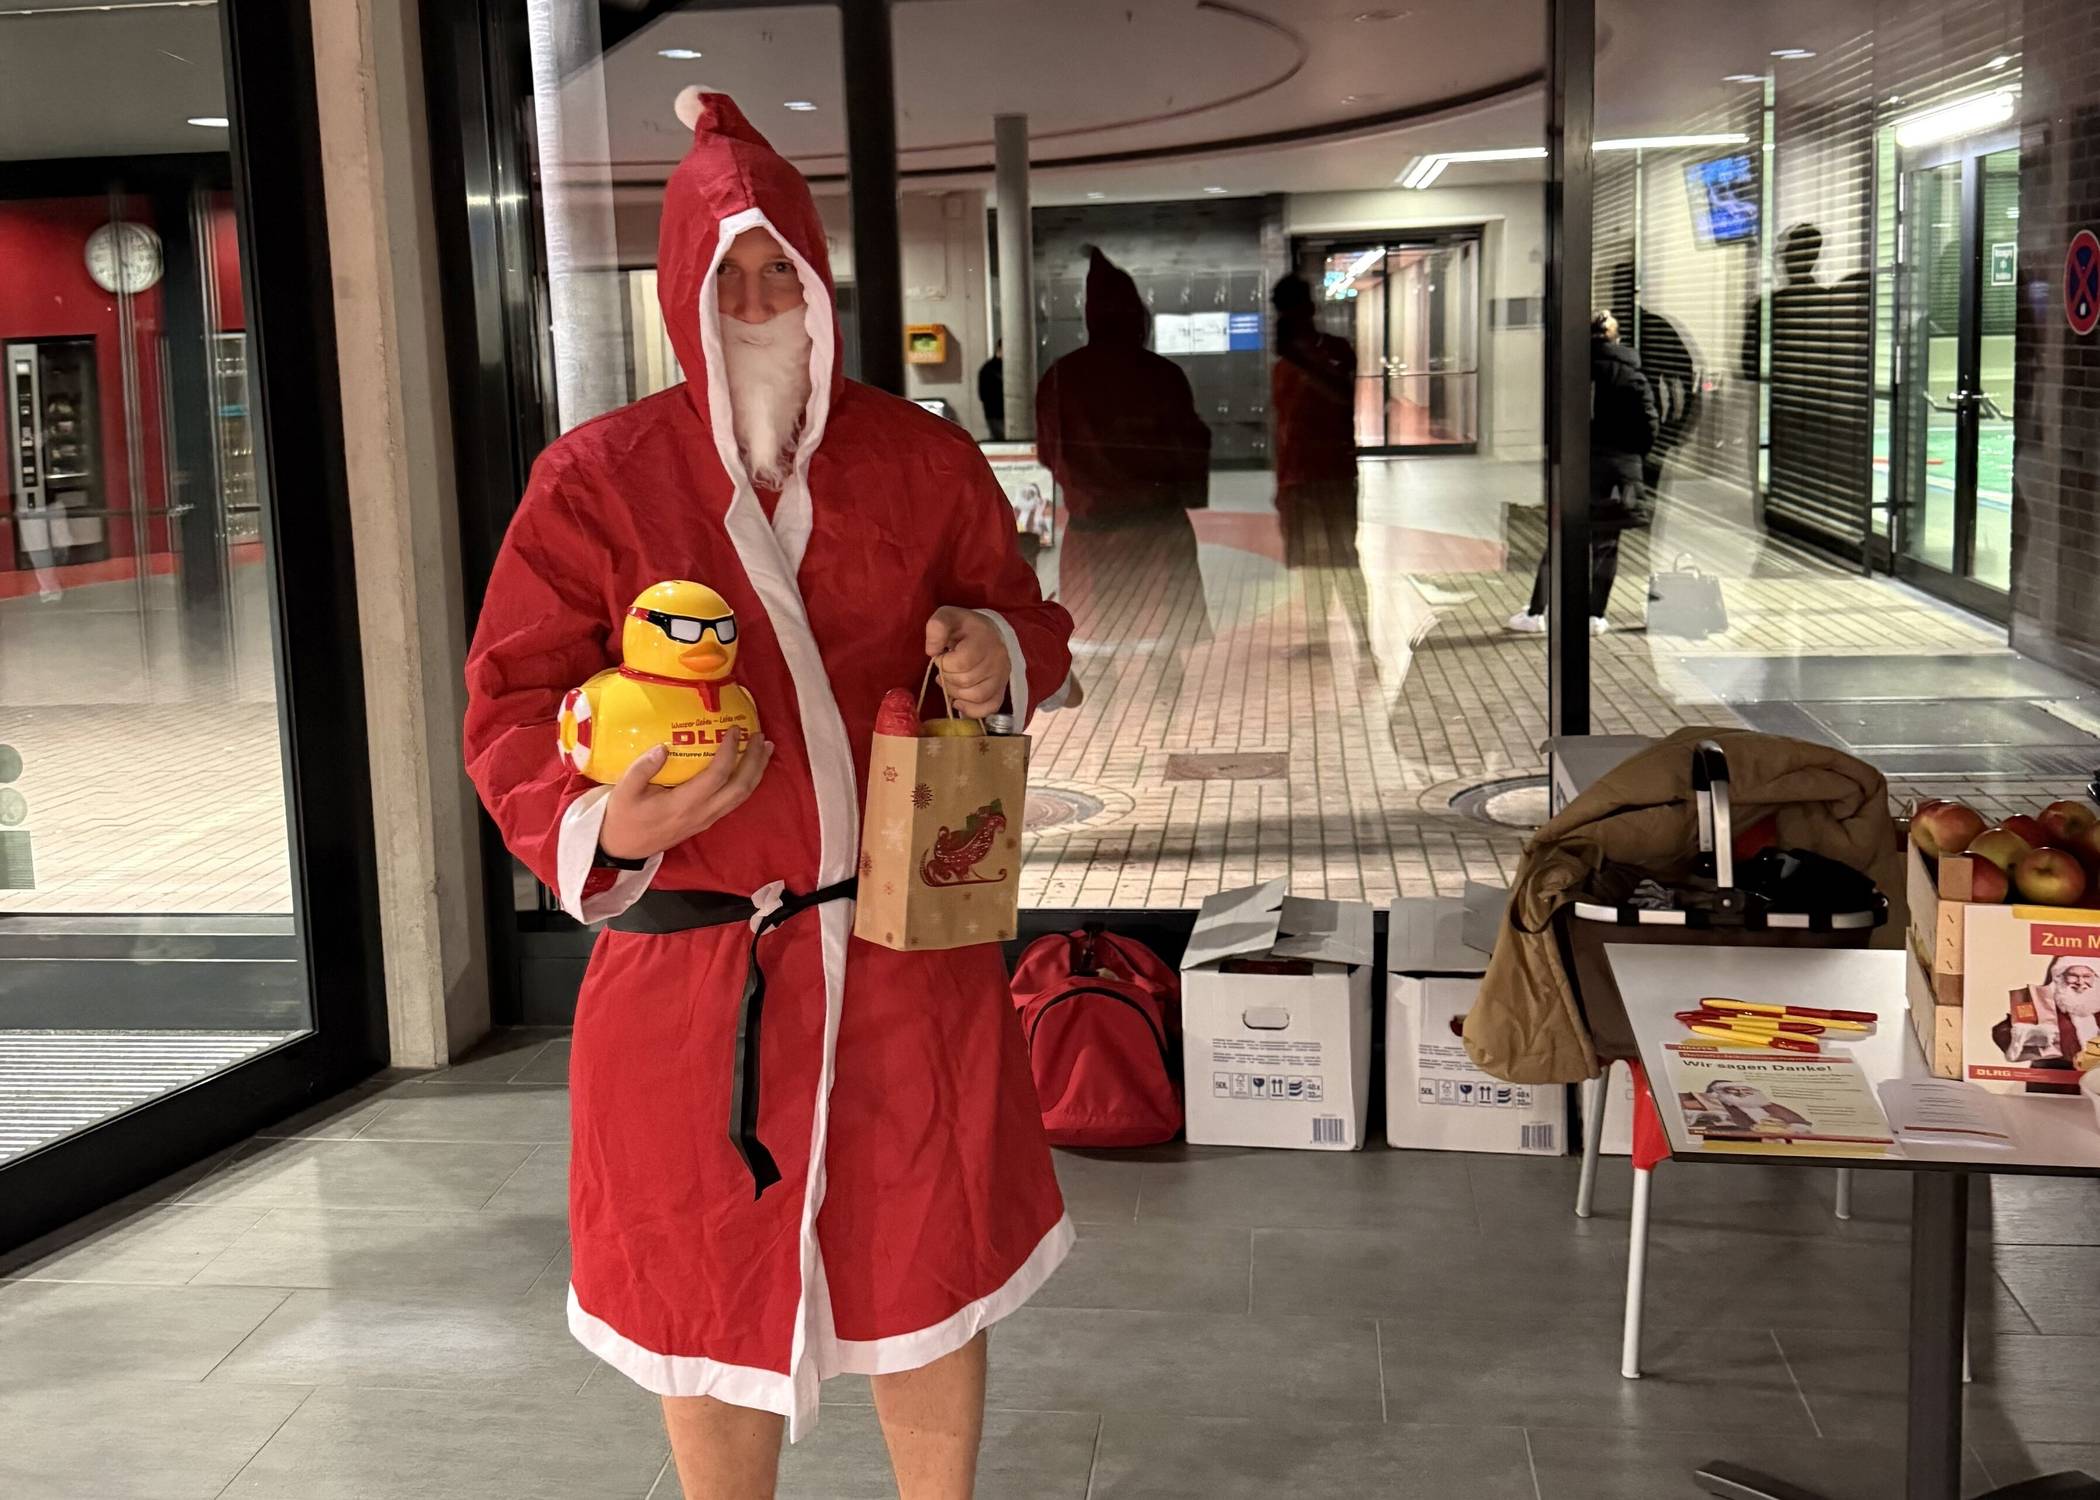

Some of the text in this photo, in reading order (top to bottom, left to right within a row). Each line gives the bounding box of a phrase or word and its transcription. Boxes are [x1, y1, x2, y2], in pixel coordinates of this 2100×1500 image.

[2041, 932, 2082, 948] Zum
[1683, 1060, 1832, 1072] Wir sagen Danke!
[1976, 1068, 2012, 1077] DLRG
